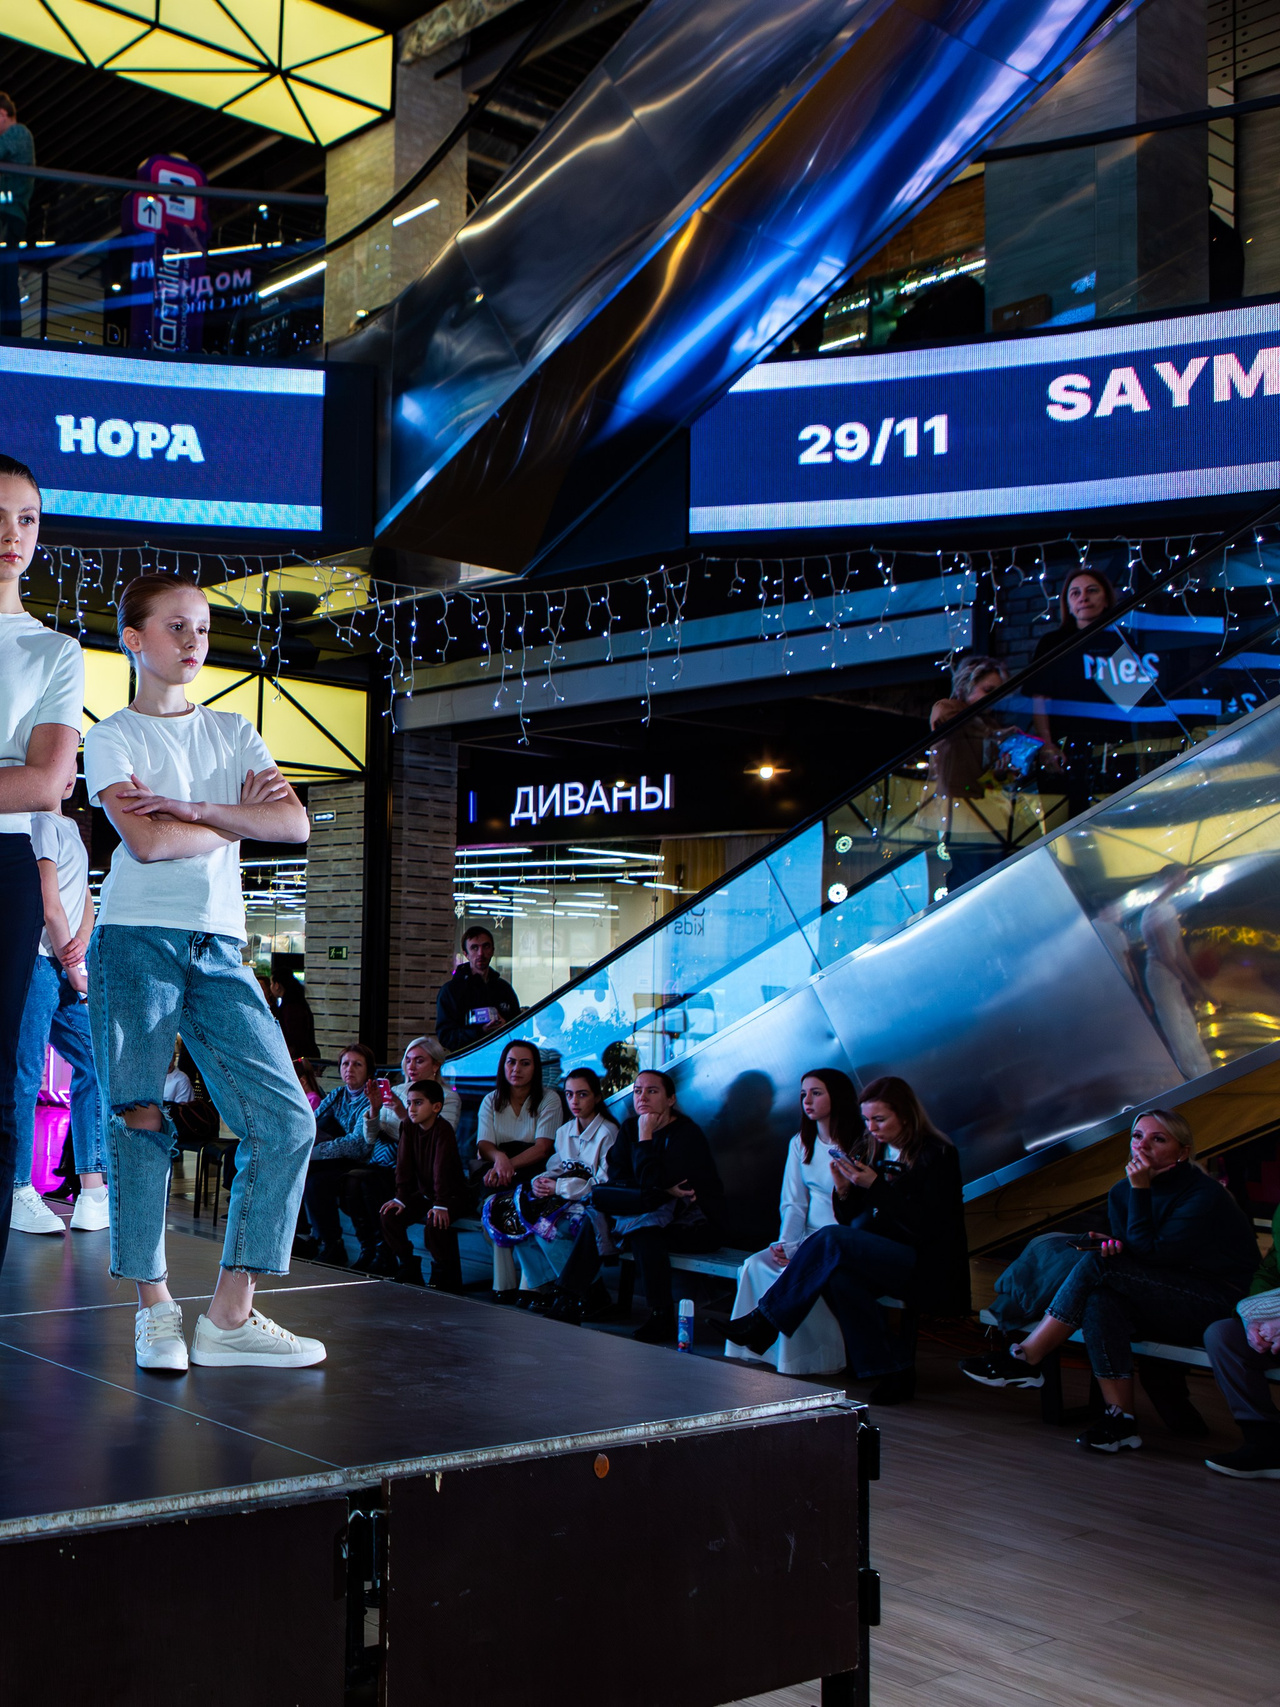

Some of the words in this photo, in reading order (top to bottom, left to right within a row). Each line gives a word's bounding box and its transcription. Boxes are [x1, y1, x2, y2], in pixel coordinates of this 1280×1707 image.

[56, 414, 205, 463] НОРА
[798, 414, 949, 466] 29/11
[509, 773, 674, 827] ДИВАНЫ
